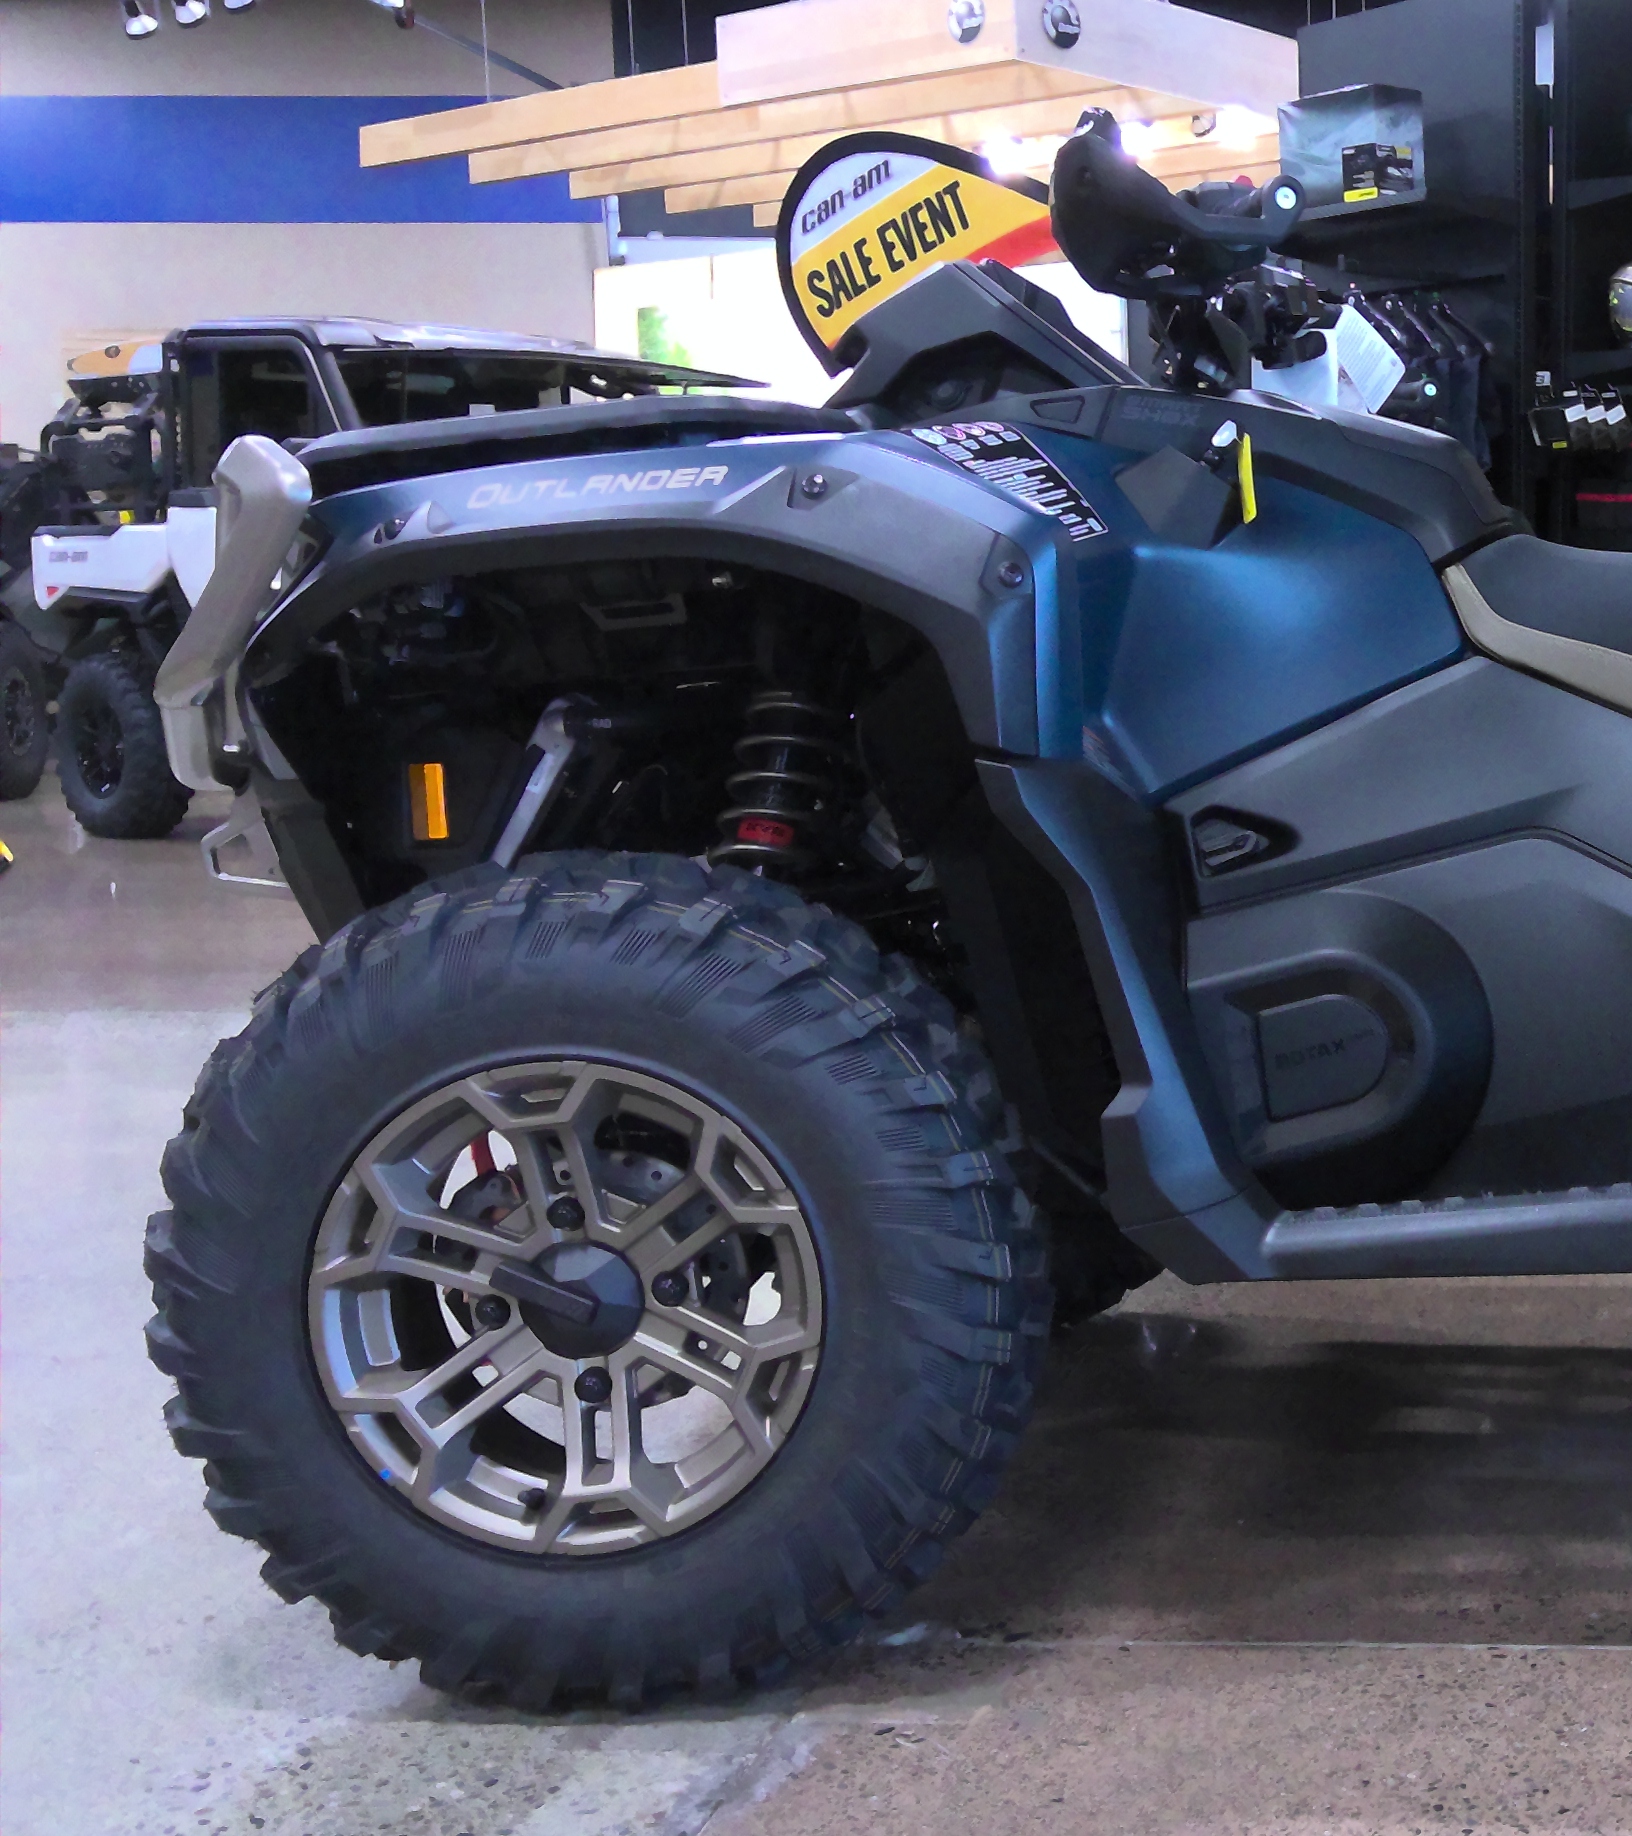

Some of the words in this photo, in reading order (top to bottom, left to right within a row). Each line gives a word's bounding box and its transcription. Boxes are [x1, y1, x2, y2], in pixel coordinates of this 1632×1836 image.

[806, 237, 881, 318] SALE
[876, 180, 970, 272] EVENT
[467, 465, 729, 509] OUTLANDER
